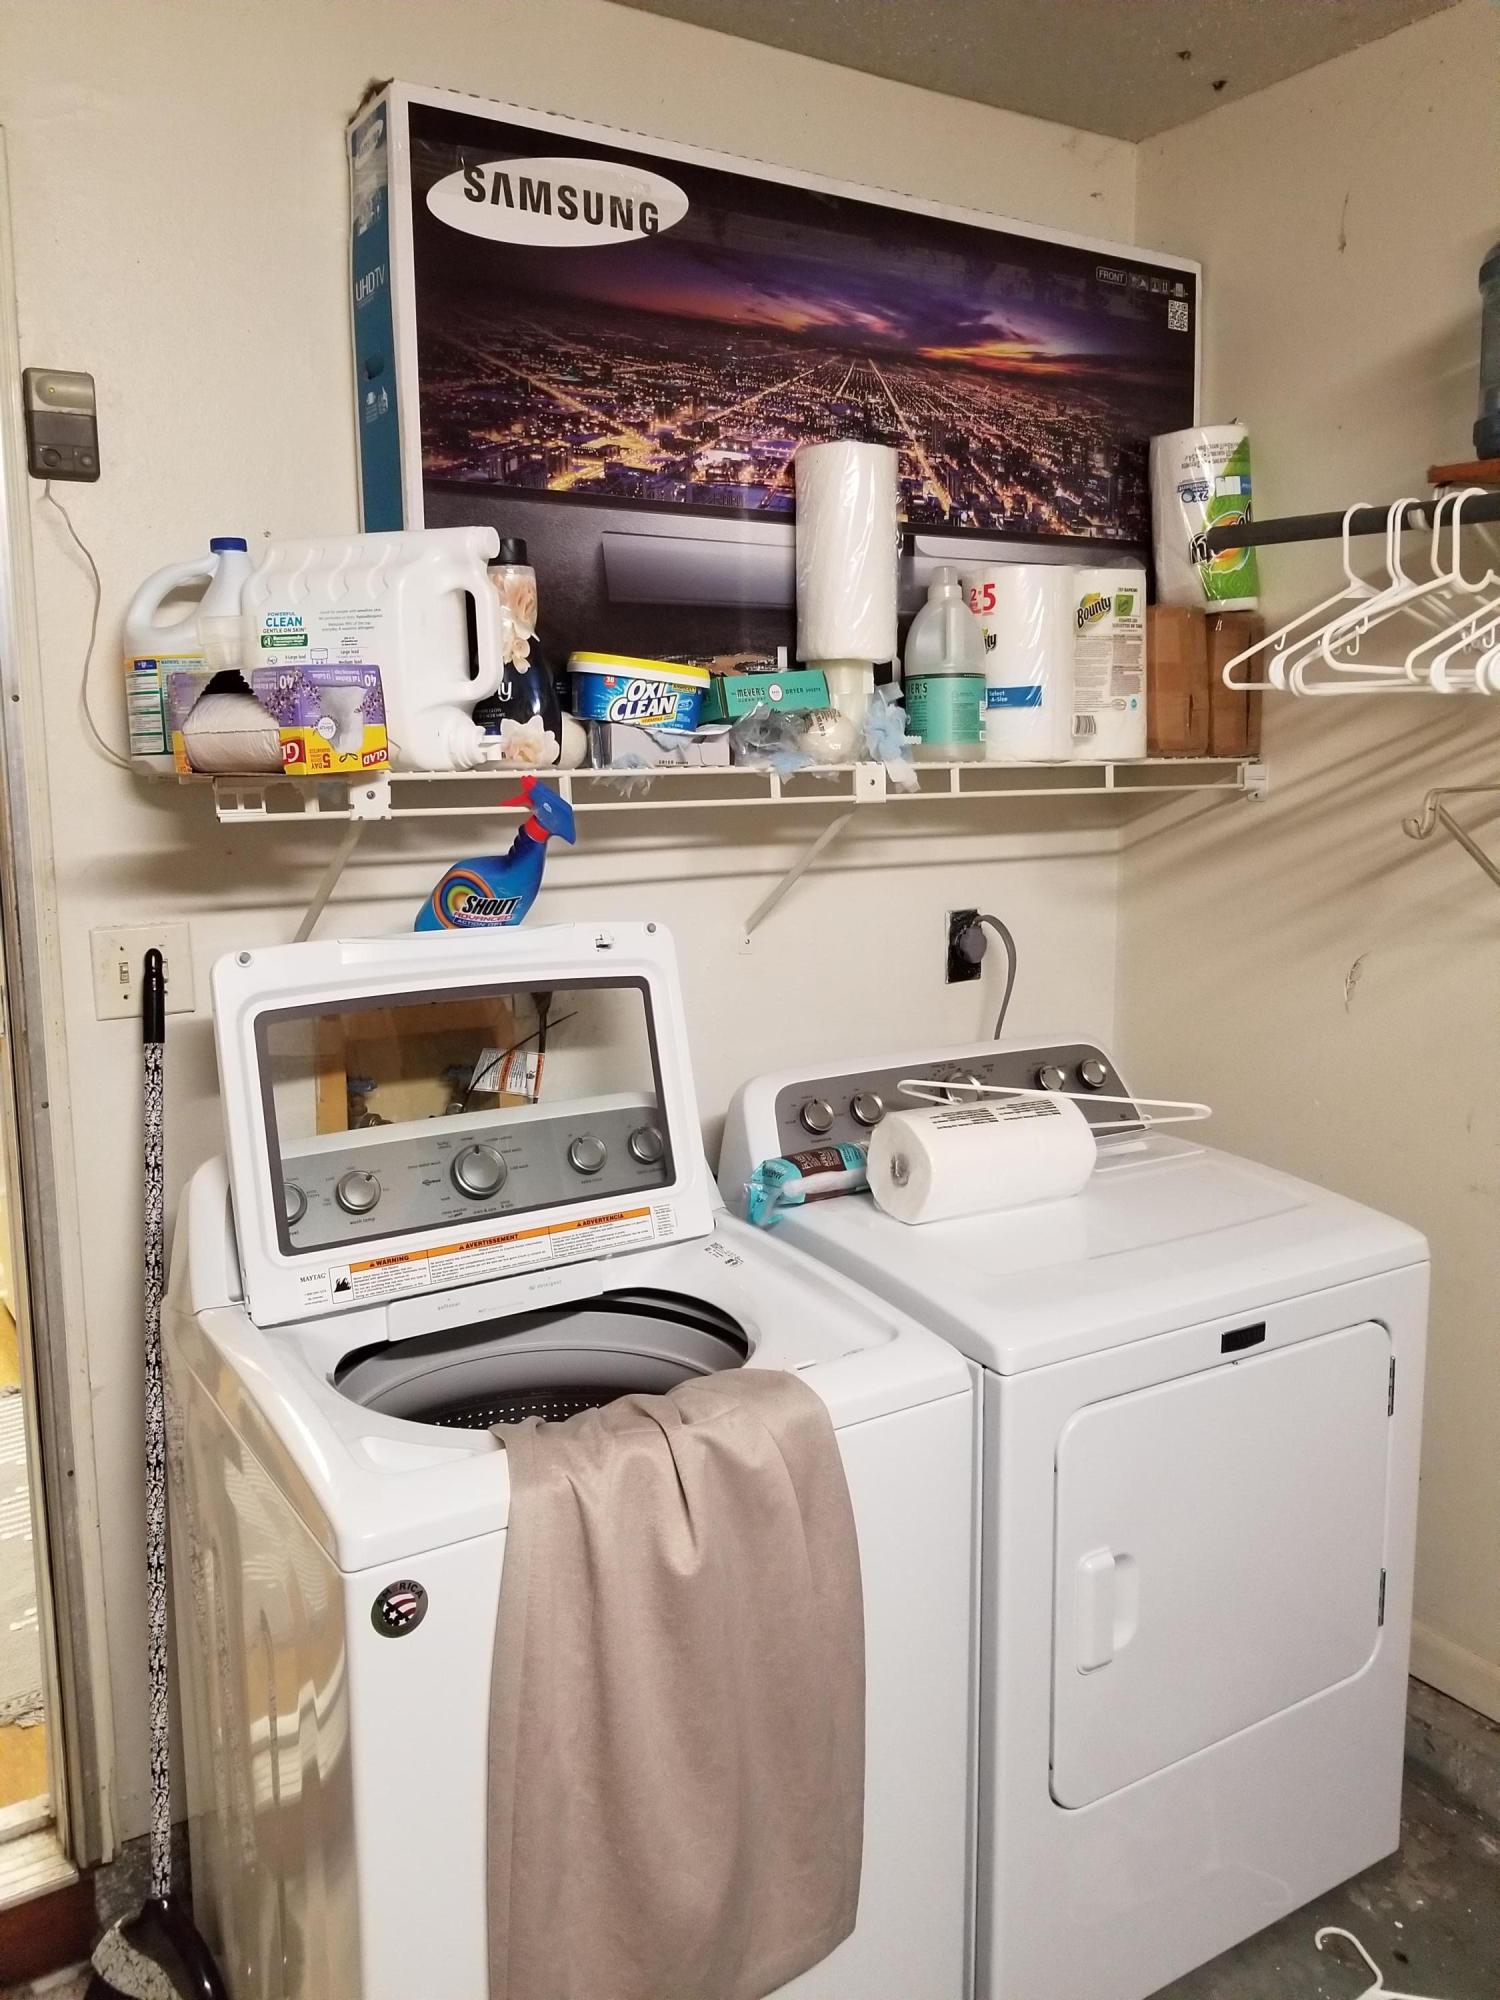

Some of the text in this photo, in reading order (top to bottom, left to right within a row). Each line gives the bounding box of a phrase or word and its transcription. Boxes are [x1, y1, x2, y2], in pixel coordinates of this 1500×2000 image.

[464, 166, 659, 236] SAMSUNG
[1098, 269, 1125, 283] FRONT
[970, 588, 977, 601] 2
[983, 583, 997, 611] 5
[1077, 595, 1112, 629] Bounty
[265, 616, 303, 628] CLEAN
[364, 674, 377, 687] 40
[627, 679, 667, 701] OXI
[737, 688, 765, 698] MEYER'S
[785, 687, 804, 695] DRYER
[610, 696, 678, 721] CLEAN
[281, 742, 300, 762] GL
[362, 749, 388, 765] GLAD
[323, 753, 331, 768] 5
[461, 895, 523, 915] SHOUT
[453, 911, 513, 922] ADVANCED
[582, 1213, 624, 1226] ADVERTENCIA
[465, 1233, 519, 1249] AVERTISSEMENT
[375, 1255, 410, 1266] WARNING
[299, 1272, 326, 1283] MAYTAG
